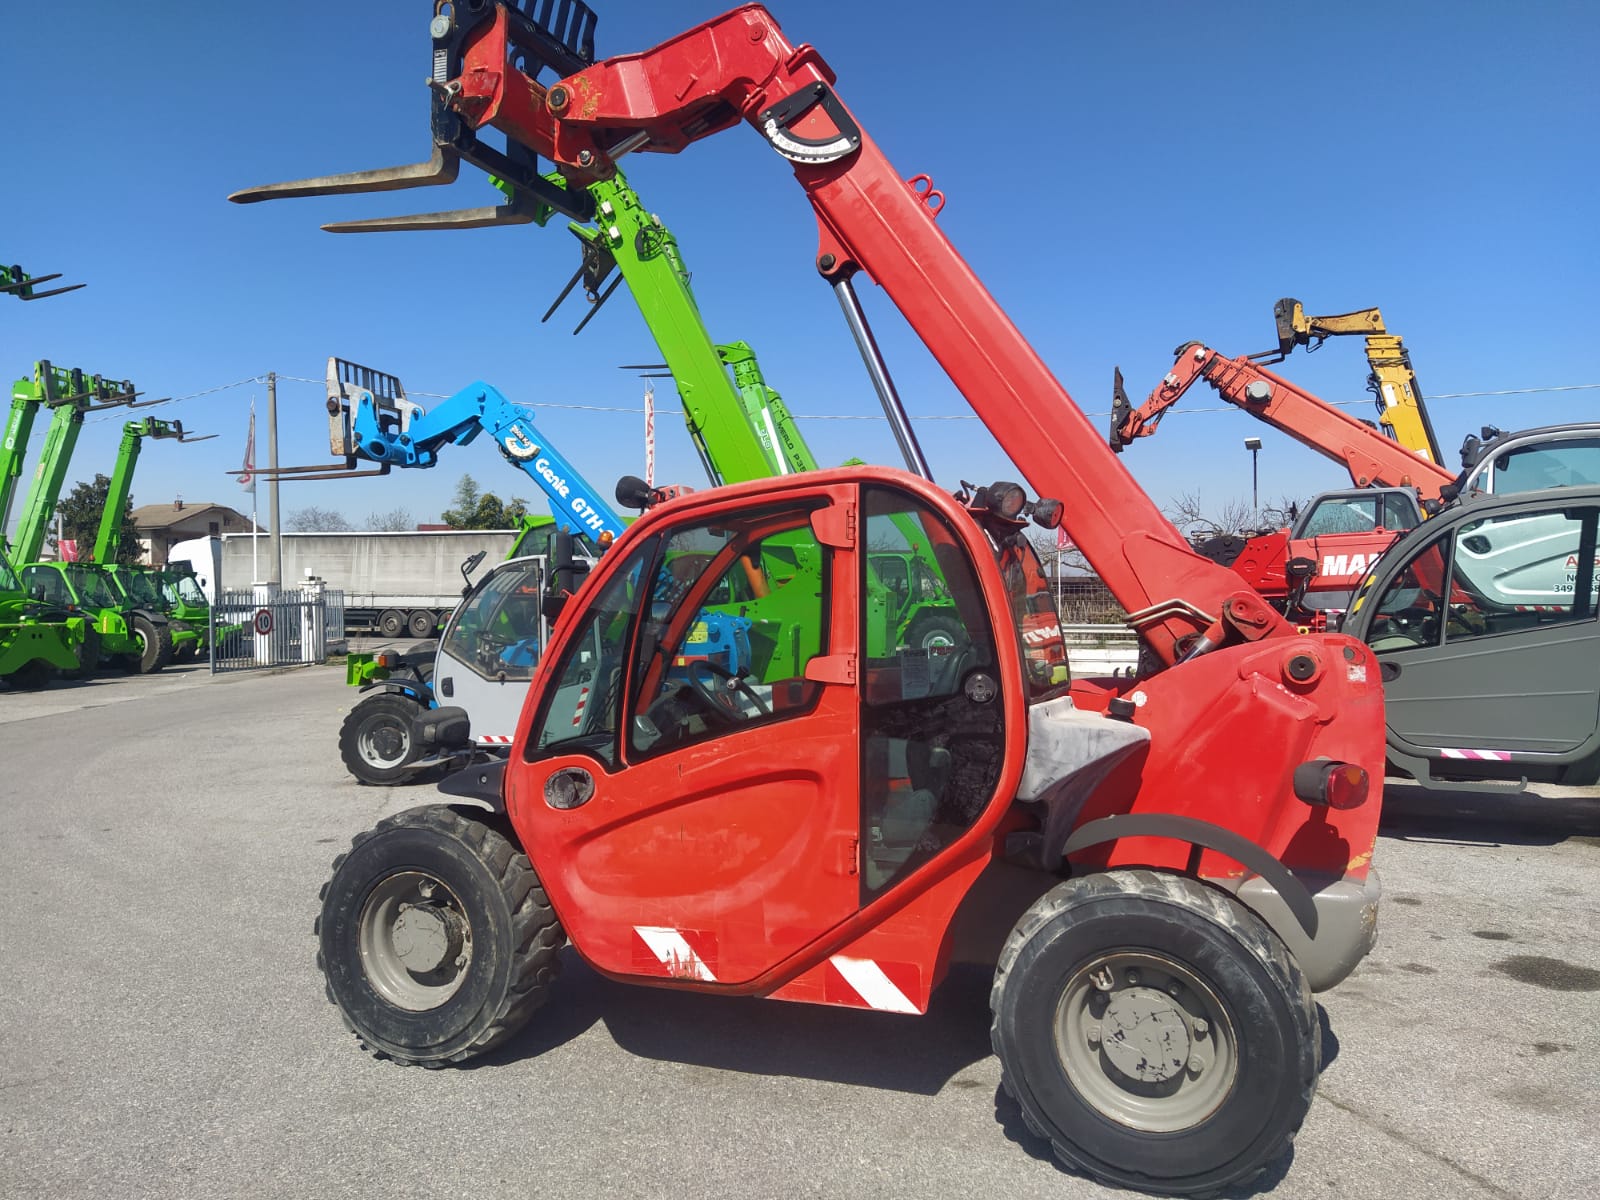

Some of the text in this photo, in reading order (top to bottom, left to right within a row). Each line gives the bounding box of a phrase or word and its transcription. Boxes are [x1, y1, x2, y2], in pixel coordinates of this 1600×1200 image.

[777, 422, 794, 450] MERLO
[535, 458, 618, 543] Genie GTH-
[260, 615, 269, 629] 10
